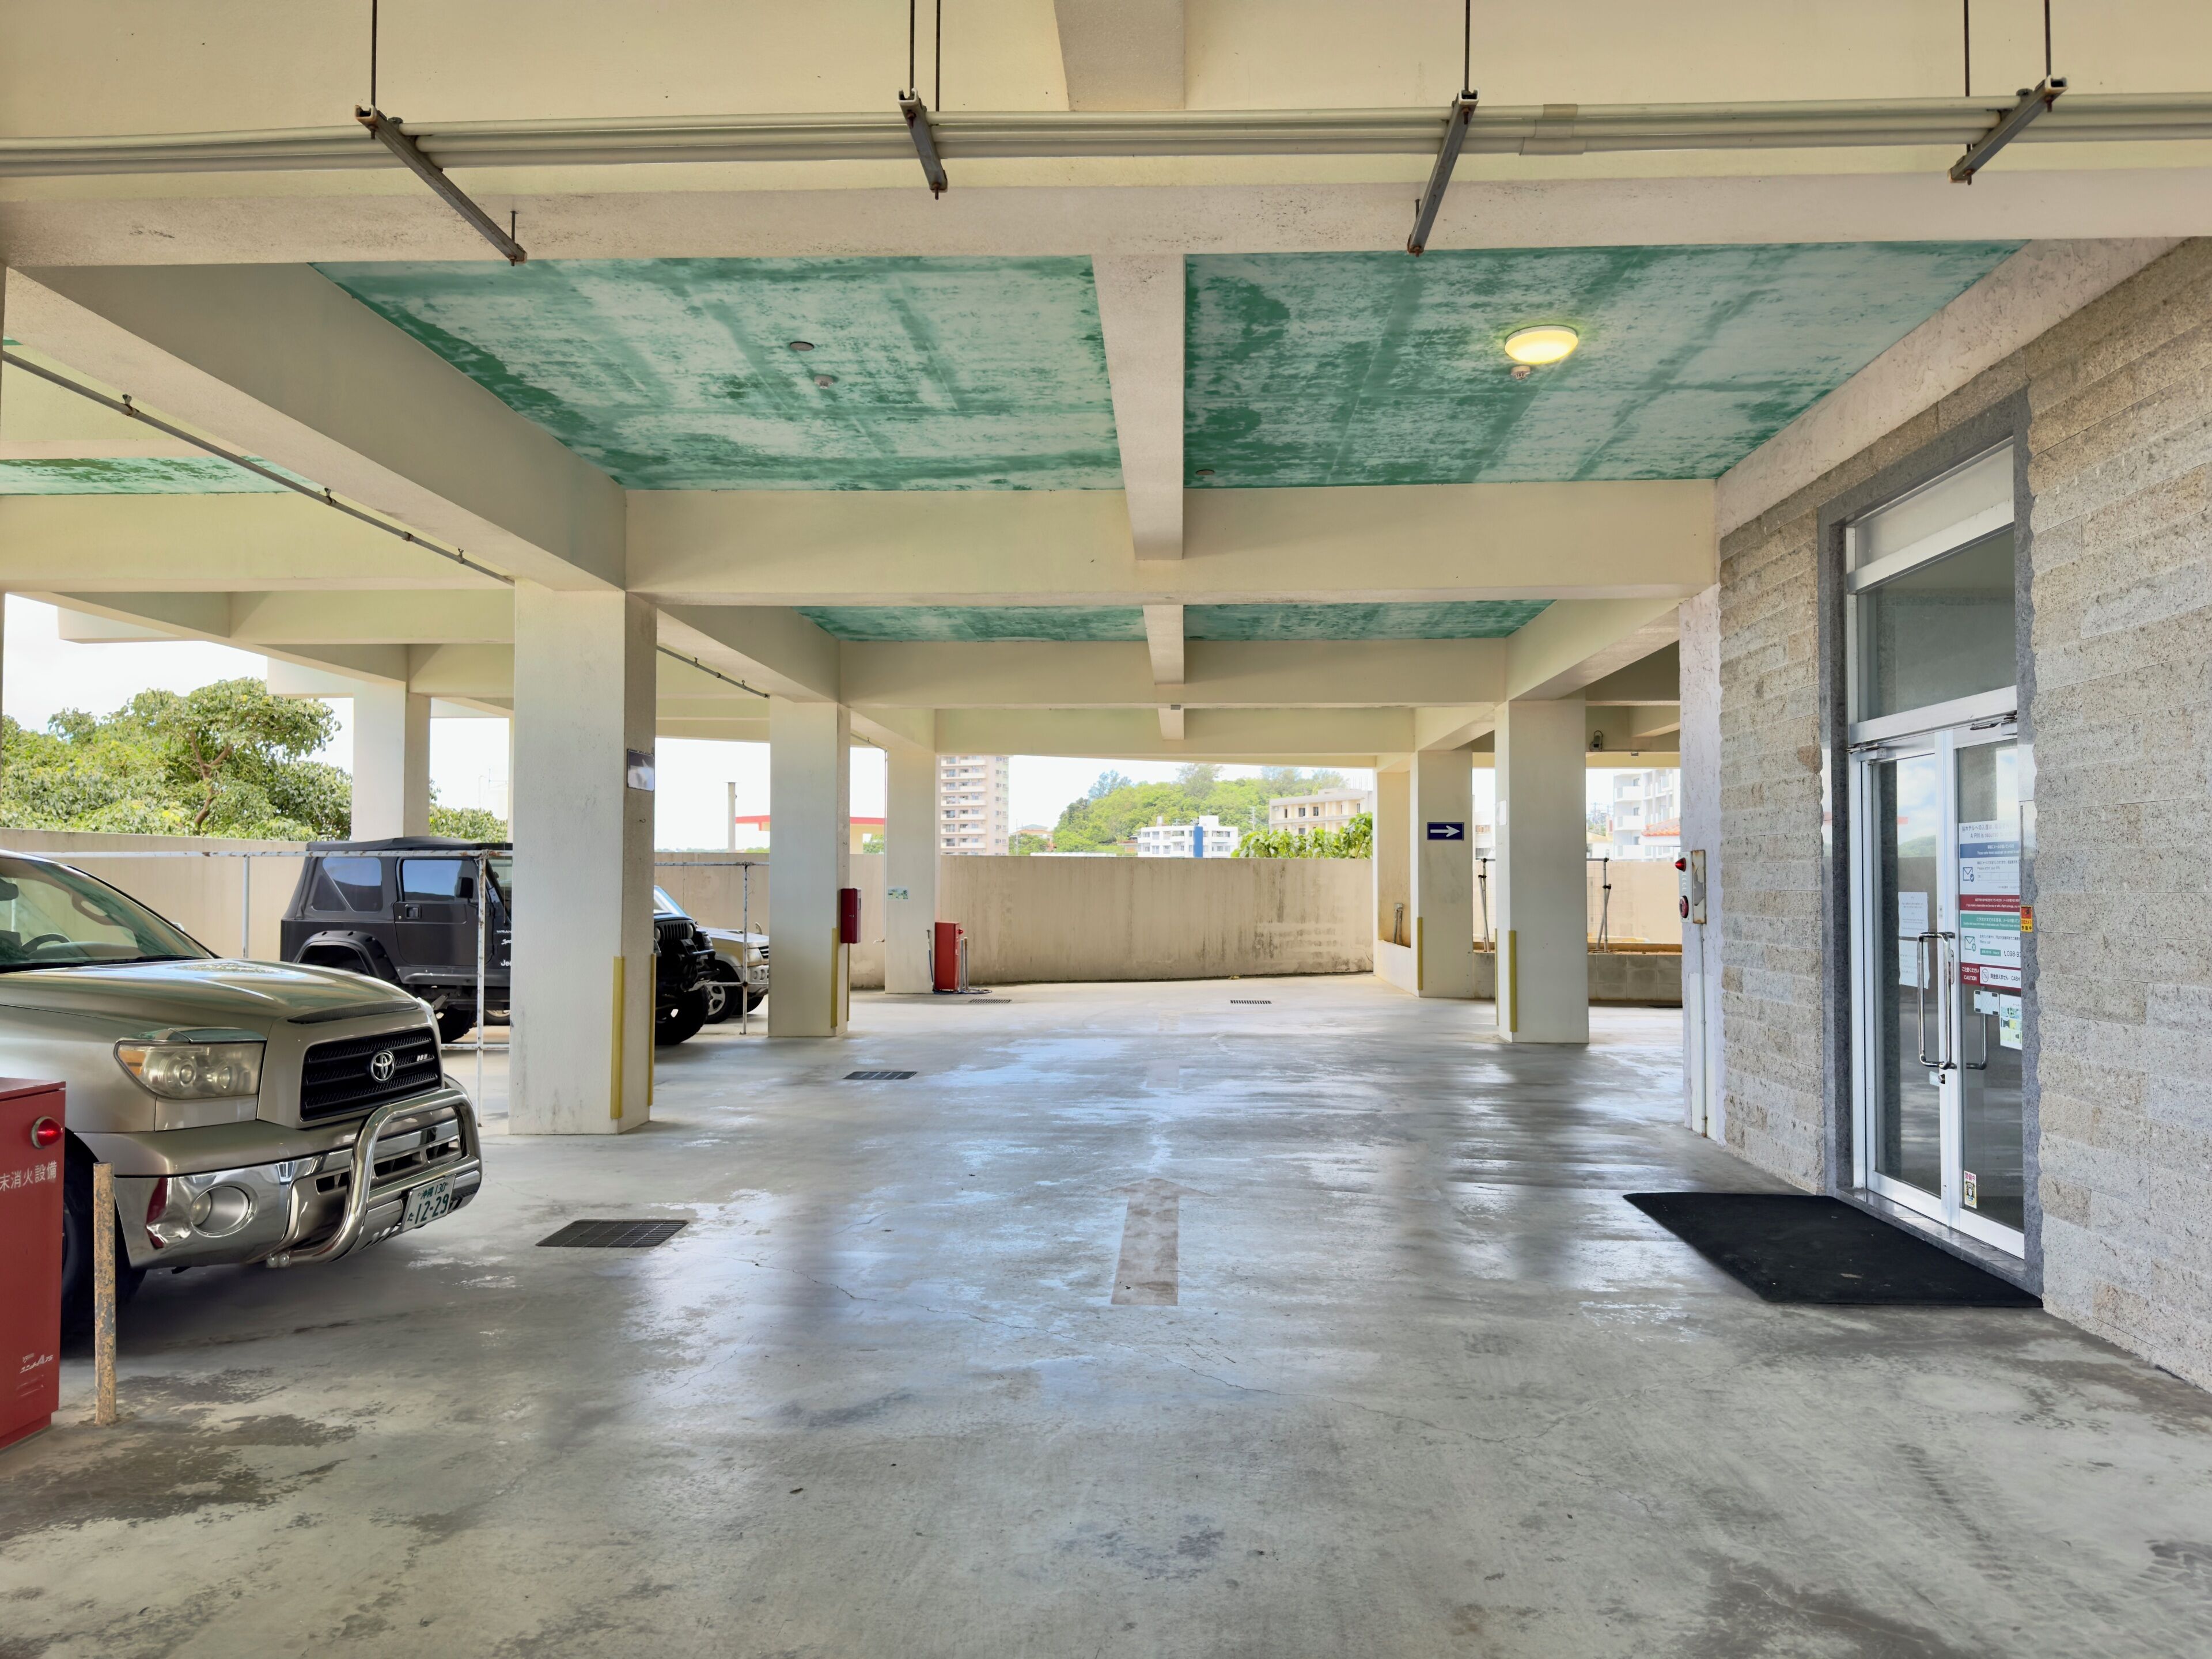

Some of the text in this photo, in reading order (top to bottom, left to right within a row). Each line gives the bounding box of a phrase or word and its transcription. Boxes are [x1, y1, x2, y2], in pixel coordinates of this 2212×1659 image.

[421, 1182, 446, 1199] 沖縄 130
[415, 1194, 449, 1224] 12-29
